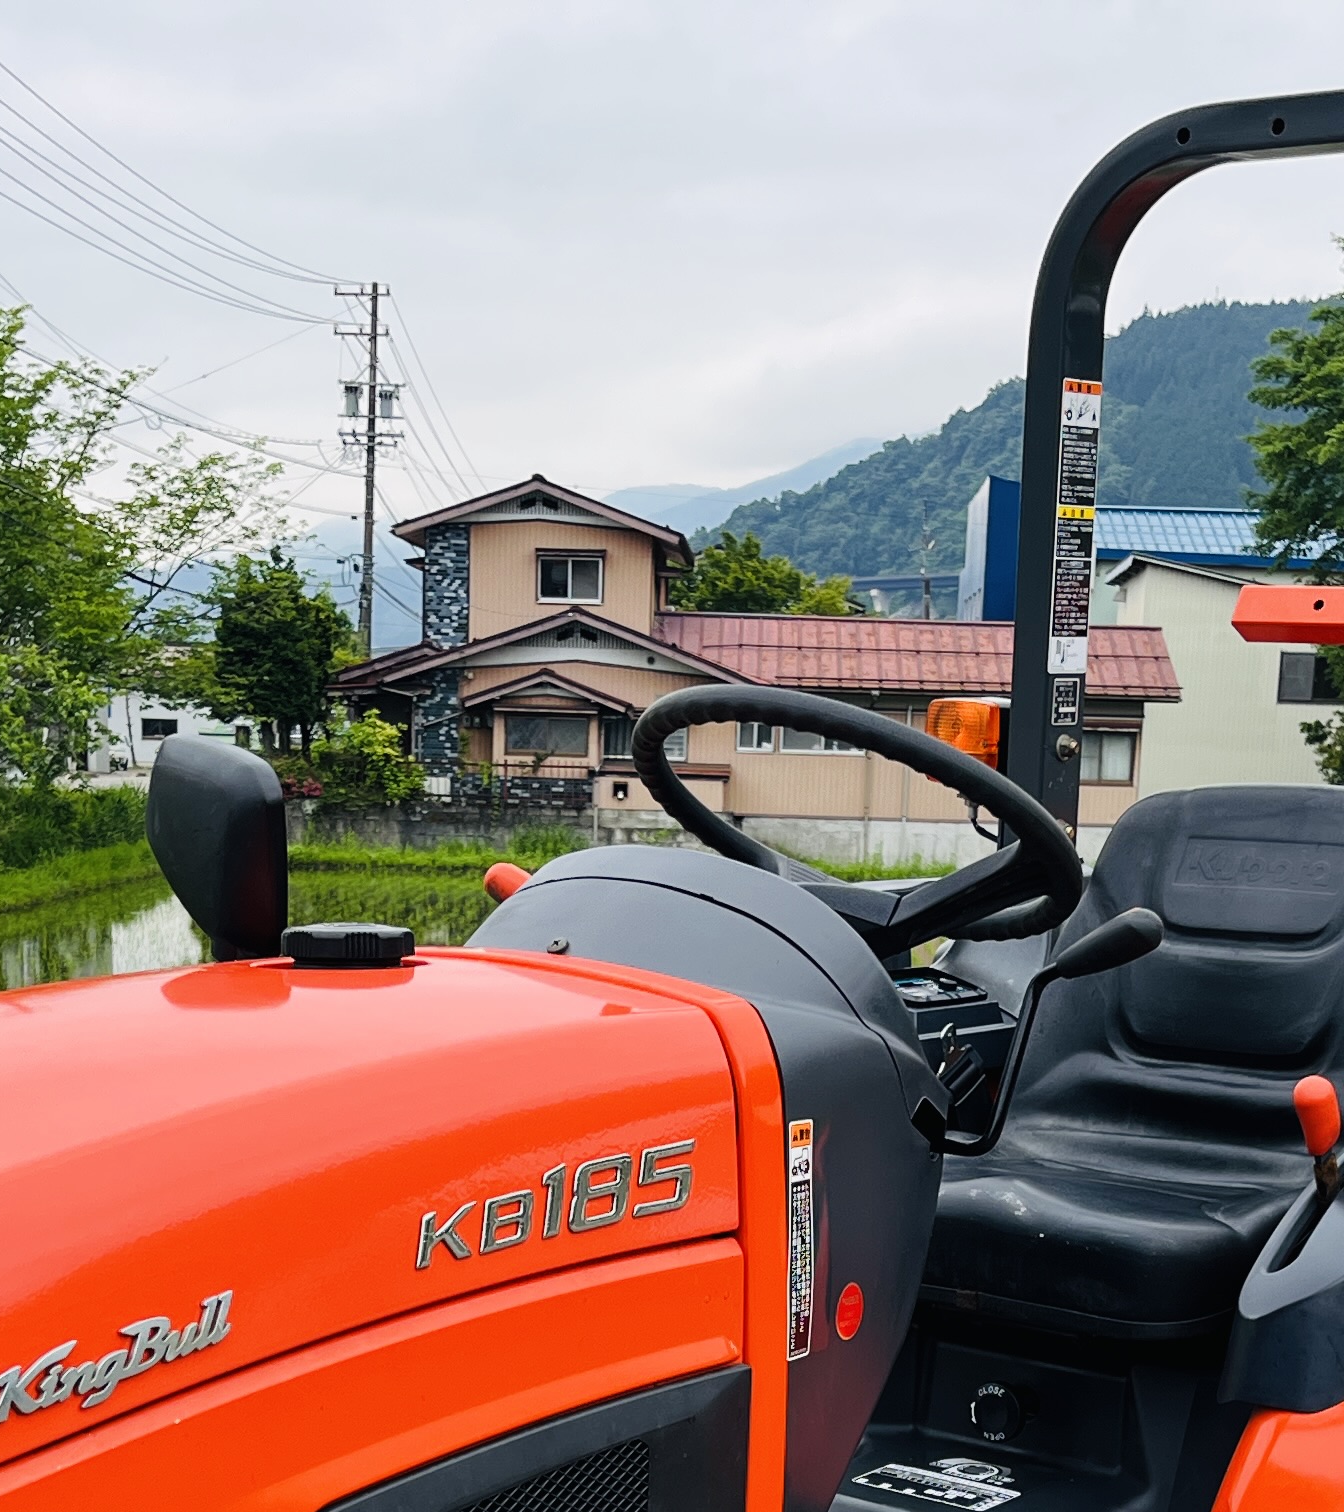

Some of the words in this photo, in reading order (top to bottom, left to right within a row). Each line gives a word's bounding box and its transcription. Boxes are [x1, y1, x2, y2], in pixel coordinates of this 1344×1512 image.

[1189, 845, 1331, 887] Kubota
[416, 1138, 696, 1270] KB185
[978, 1385, 1006, 1397] CLOSE
